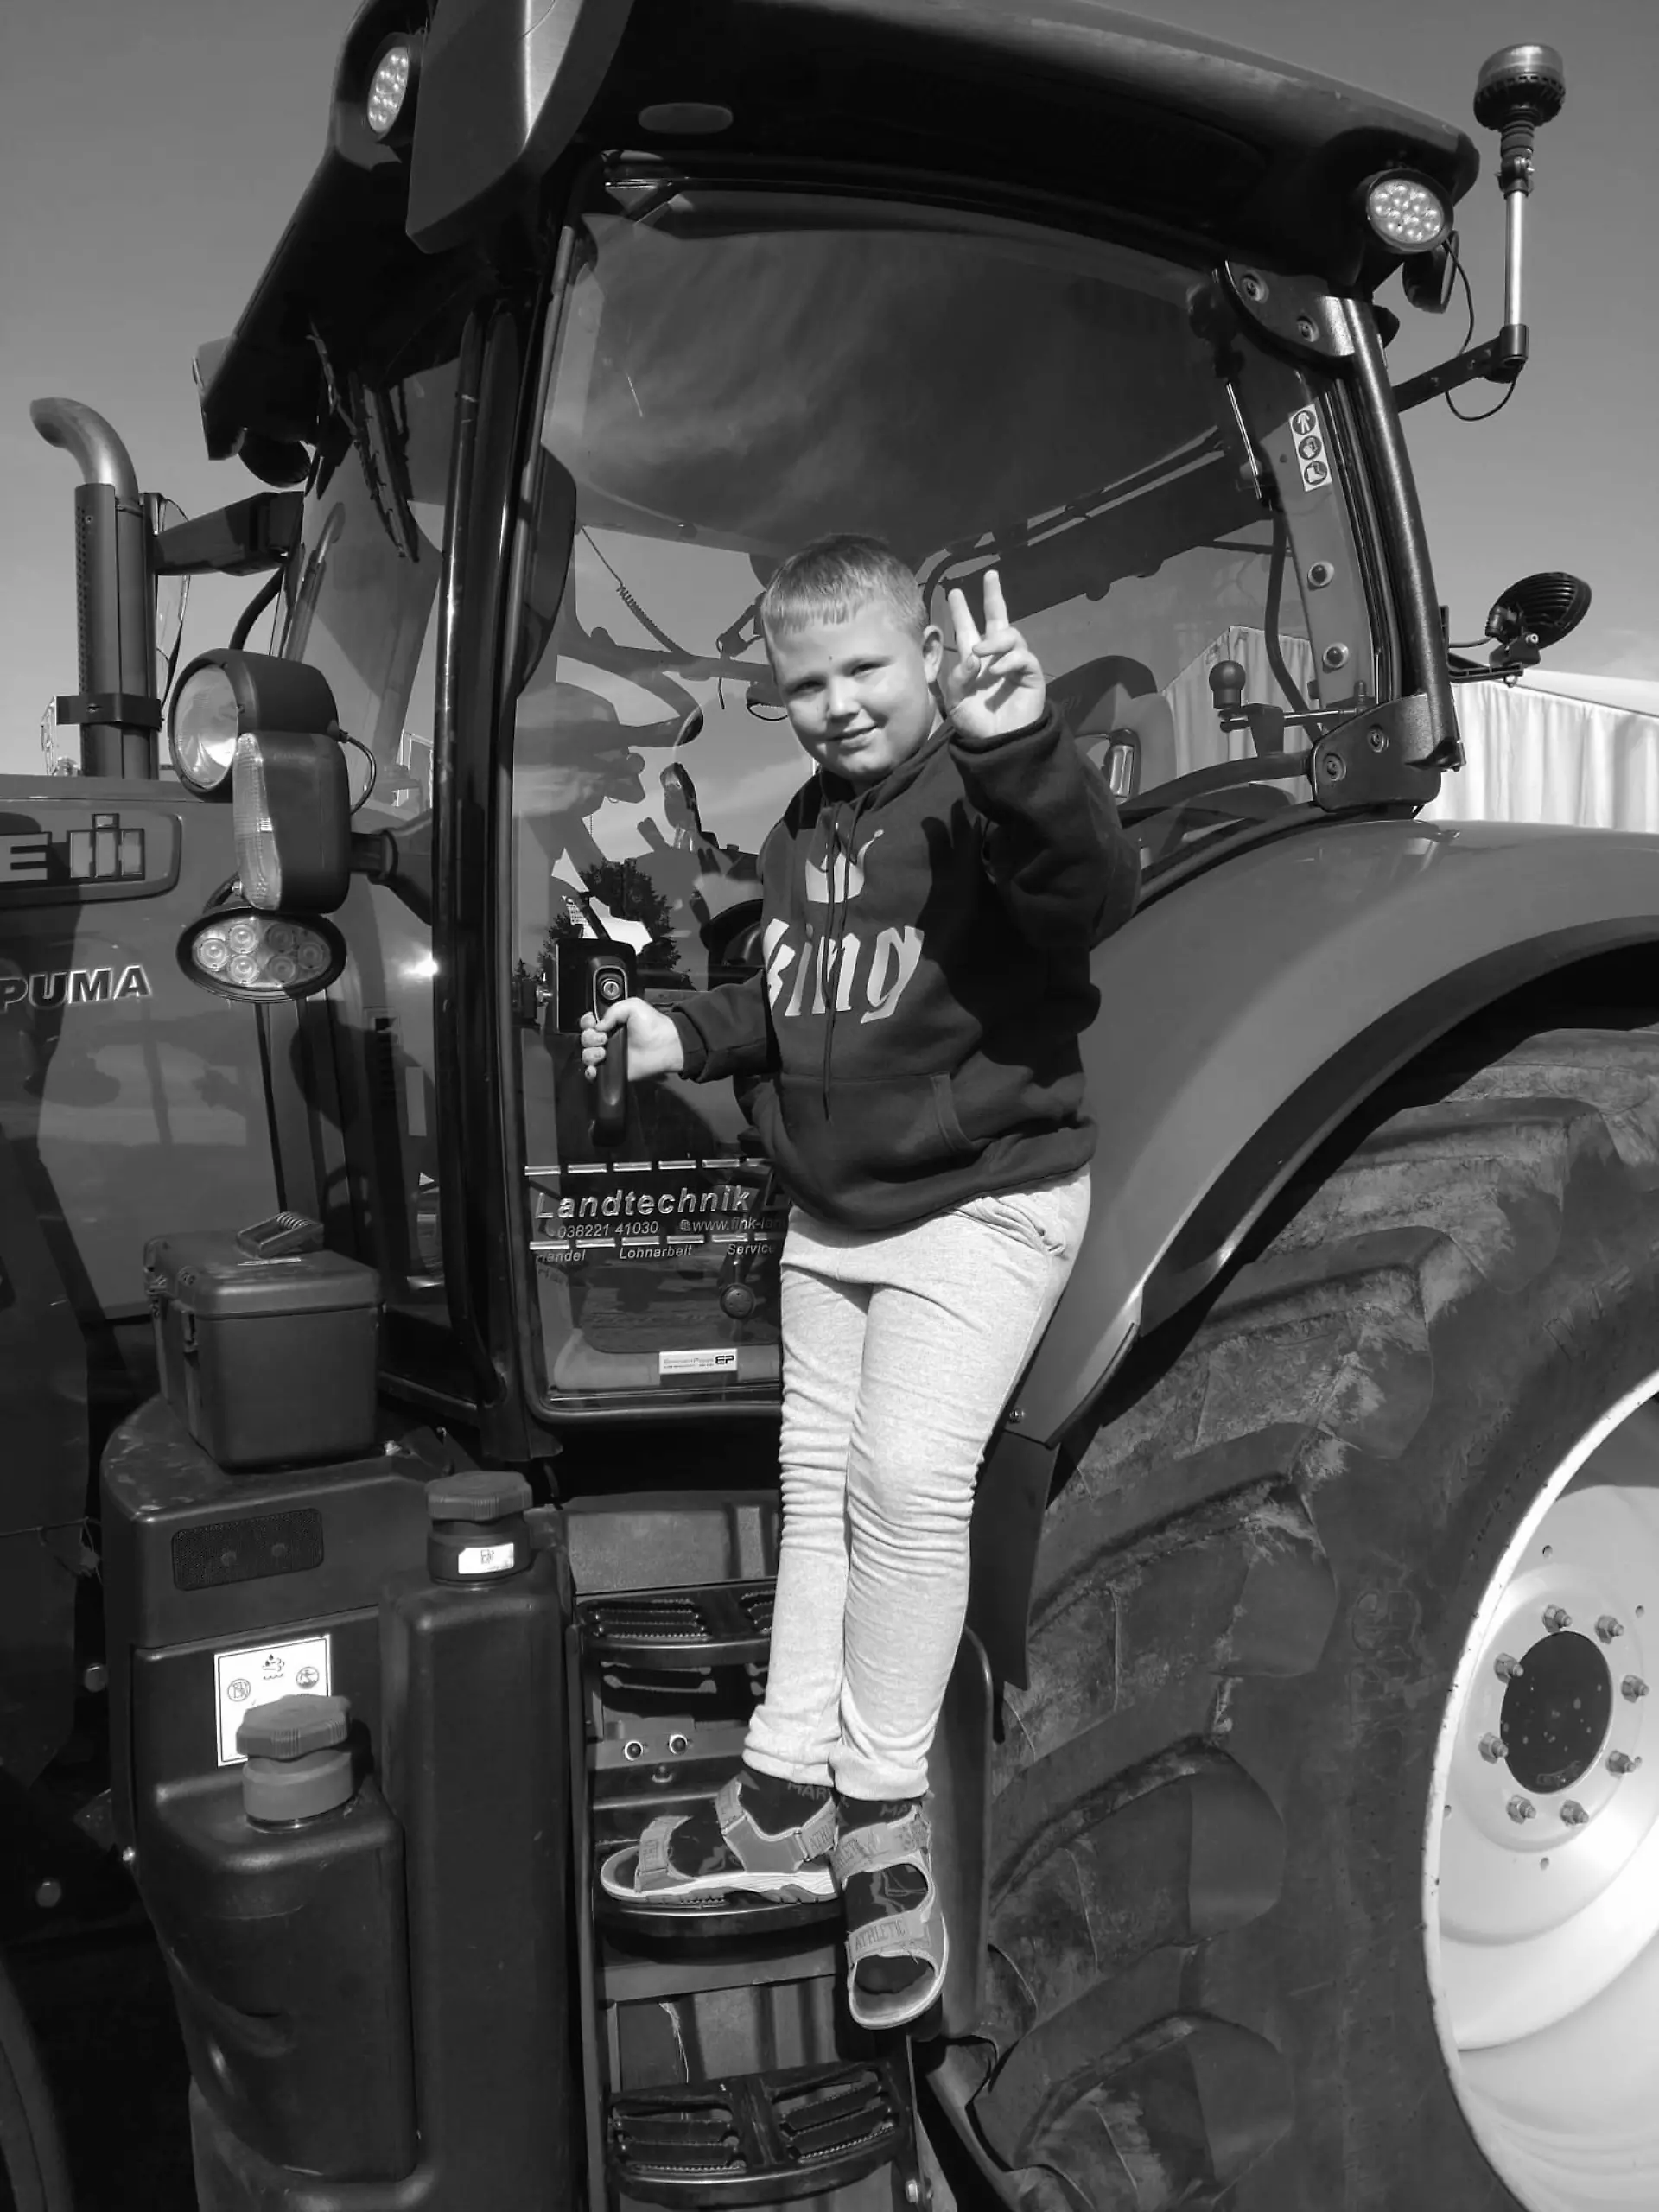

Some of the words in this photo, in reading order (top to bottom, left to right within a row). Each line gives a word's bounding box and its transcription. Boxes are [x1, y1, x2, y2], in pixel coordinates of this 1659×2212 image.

[0, 964, 152, 1011] PUMA
[535, 1185, 750, 1218] Landtechnik
[557, 1224, 609, 1239] 038221
[614, 1221, 658, 1236] 41030
[619, 1245, 692, 1259] Lohnarbeit
